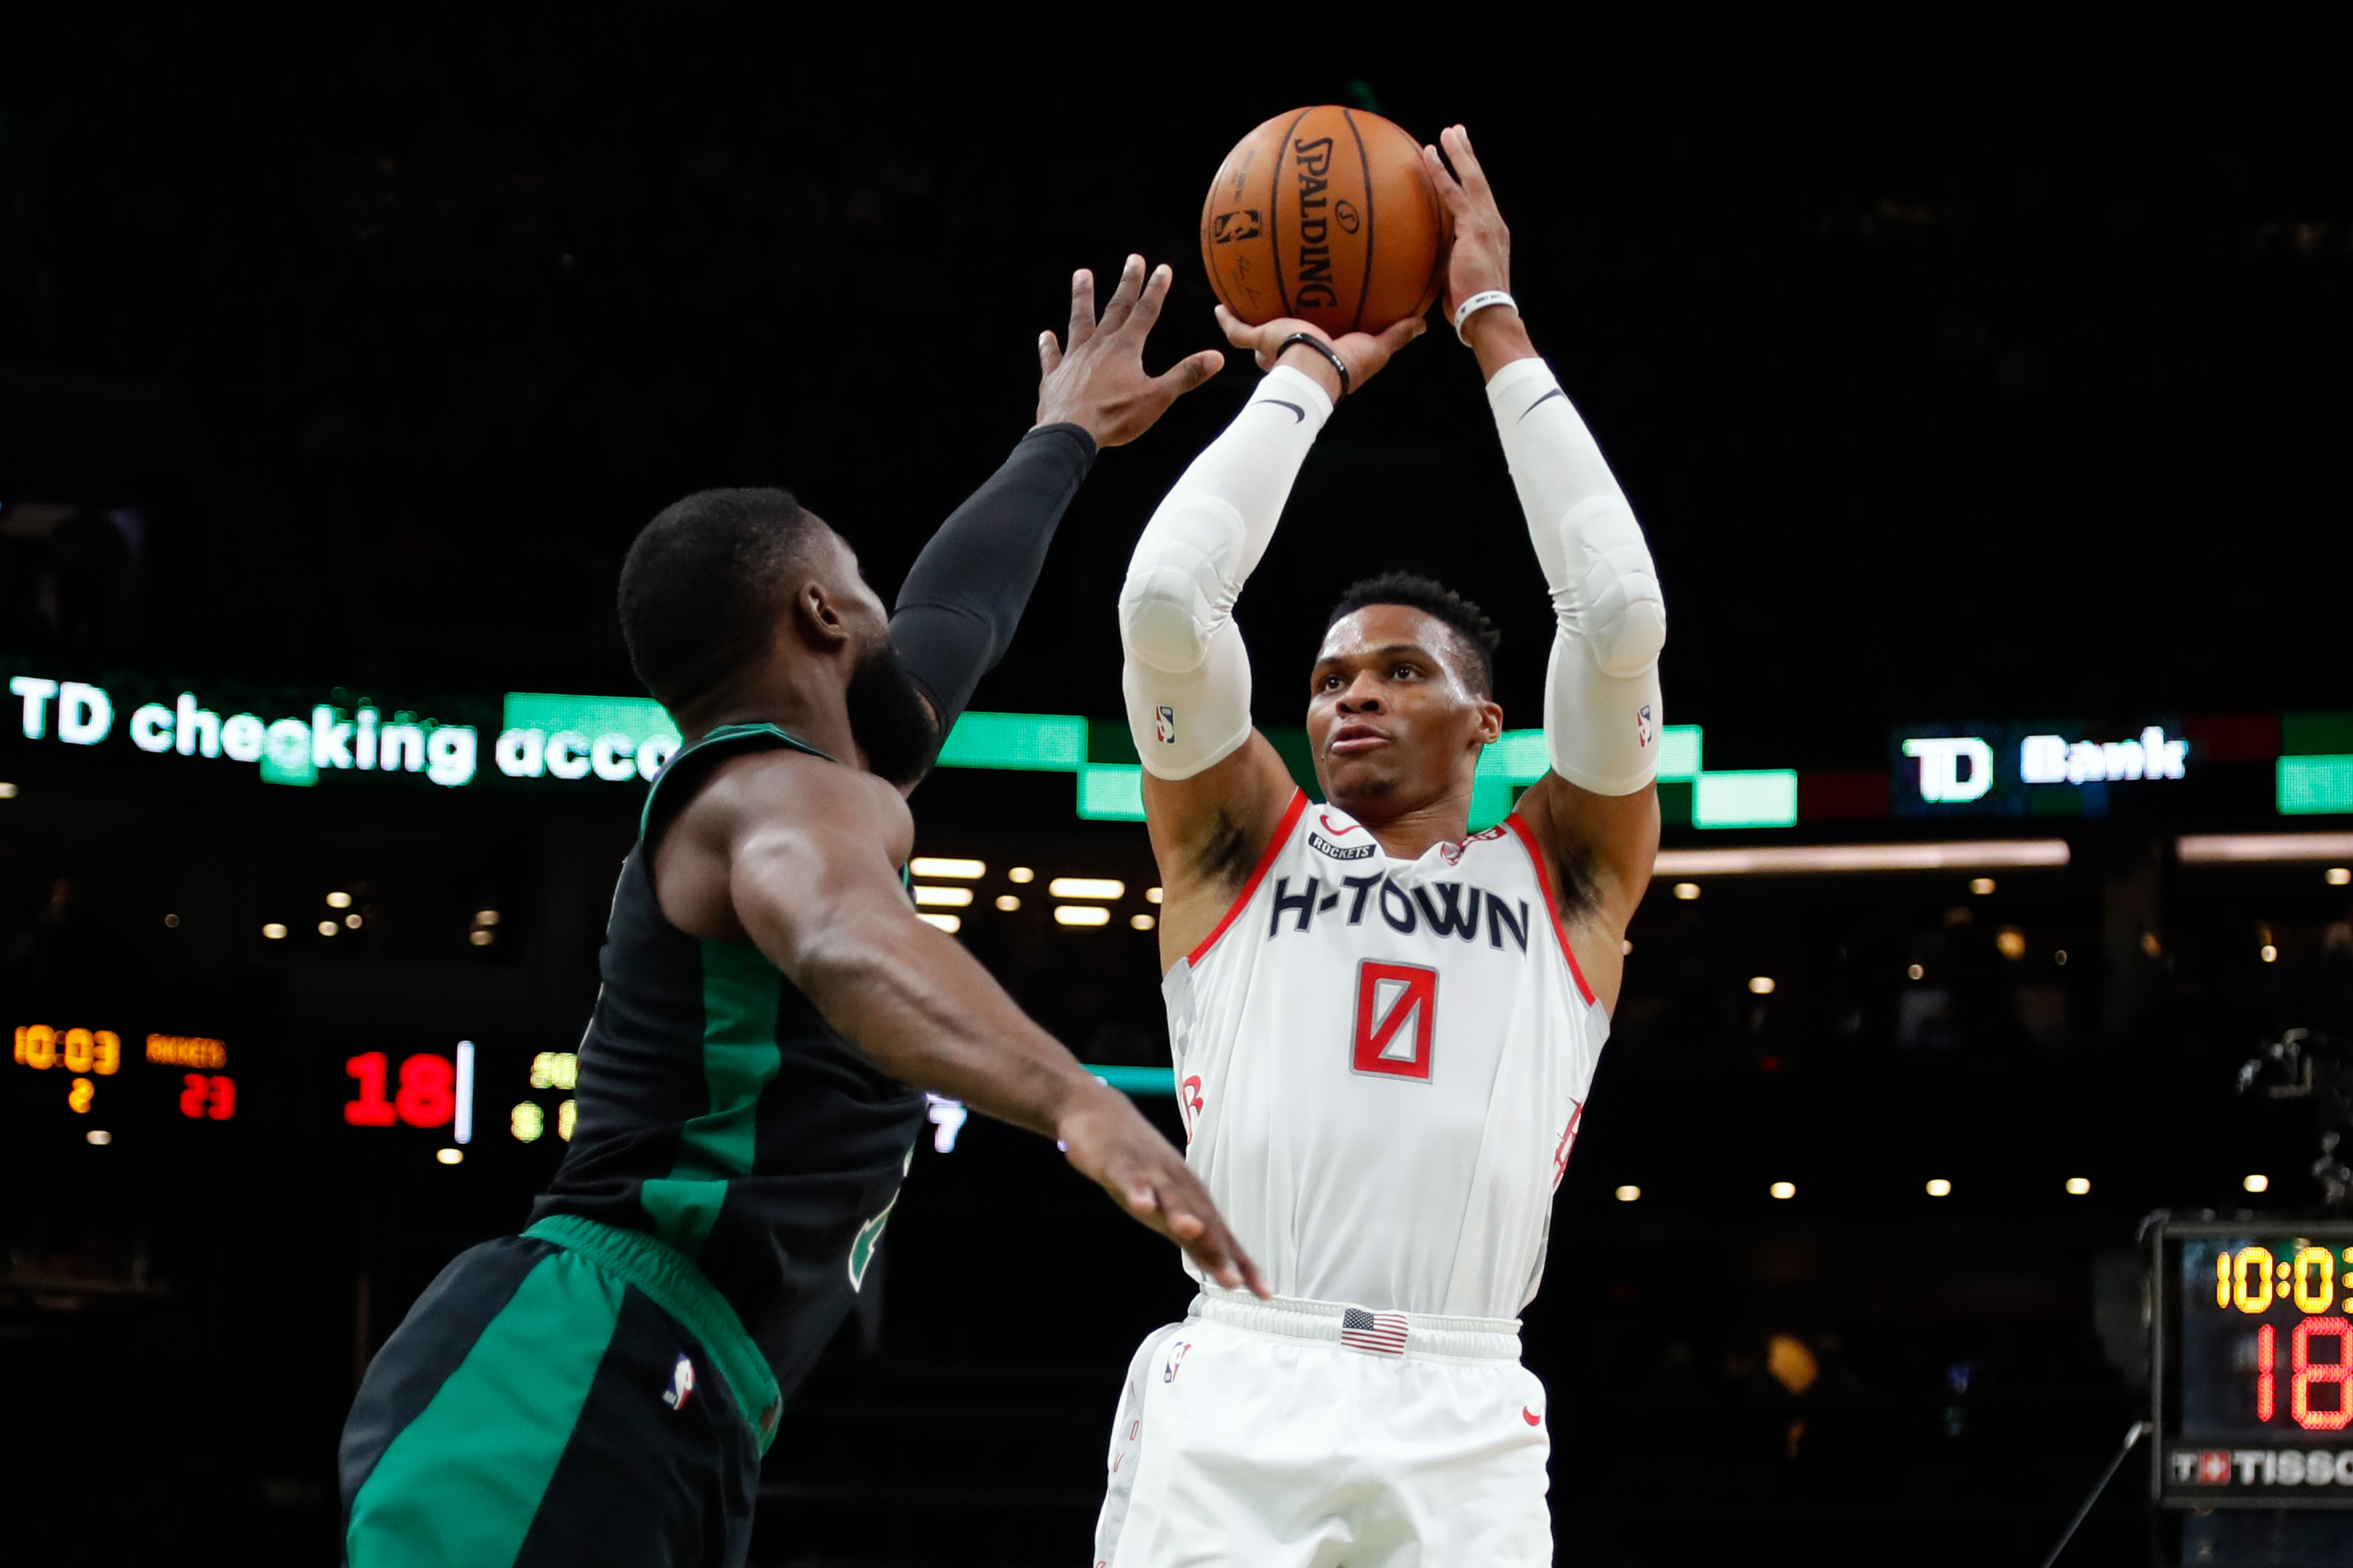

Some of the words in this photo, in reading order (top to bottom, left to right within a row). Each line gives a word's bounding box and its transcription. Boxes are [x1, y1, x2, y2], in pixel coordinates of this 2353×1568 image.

[1294, 137, 1338, 309] SPALDING
[10, 676, 114, 746] TD
[130, 691, 478, 786] checking
[1902, 737, 1994, 803] TD
[2020, 725, 2189, 786] Bank
[1312, 835, 1371, 859] ROCKETS
[1267, 867, 1530, 963] H-TOWN
[14, 1024, 121, 1076] 10:03
[1348, 957, 1441, 1085] 0
[180, 1073, 236, 1121] 23
[344, 1051, 455, 1128] 18
[2257, 1315, 2353, 1430] 18
[2233, 1449, 2353, 1485] TISSO
